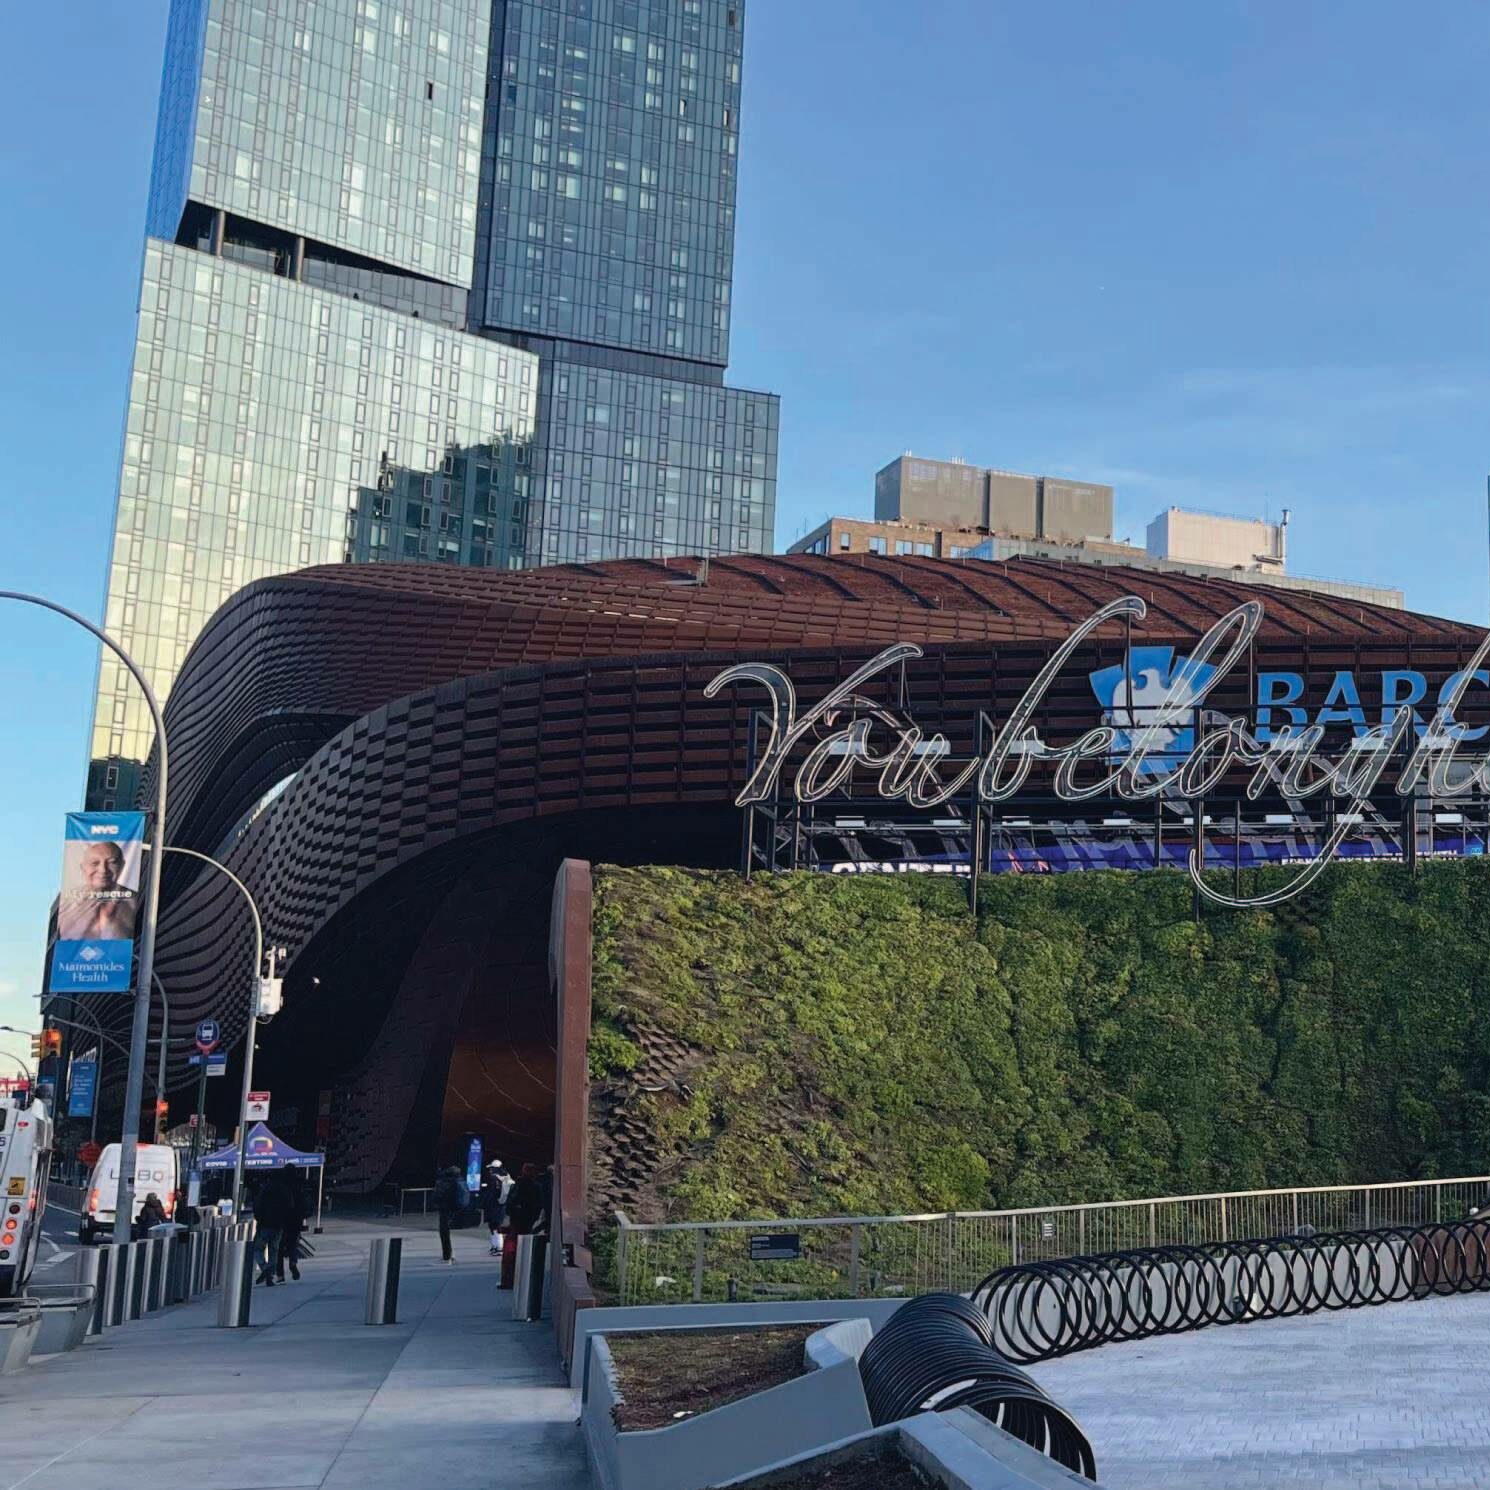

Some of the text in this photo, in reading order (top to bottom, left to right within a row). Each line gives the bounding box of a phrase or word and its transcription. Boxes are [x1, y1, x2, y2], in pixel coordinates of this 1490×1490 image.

[703, 643, 980, 807] You
[978, 596, 1413, 907] belong
[91, 825, 119, 835] NYC
[90, 889, 133, 899] rescue
[72, 971, 109, 983] Health
[110, 1167, 164, 1183] LBQ
